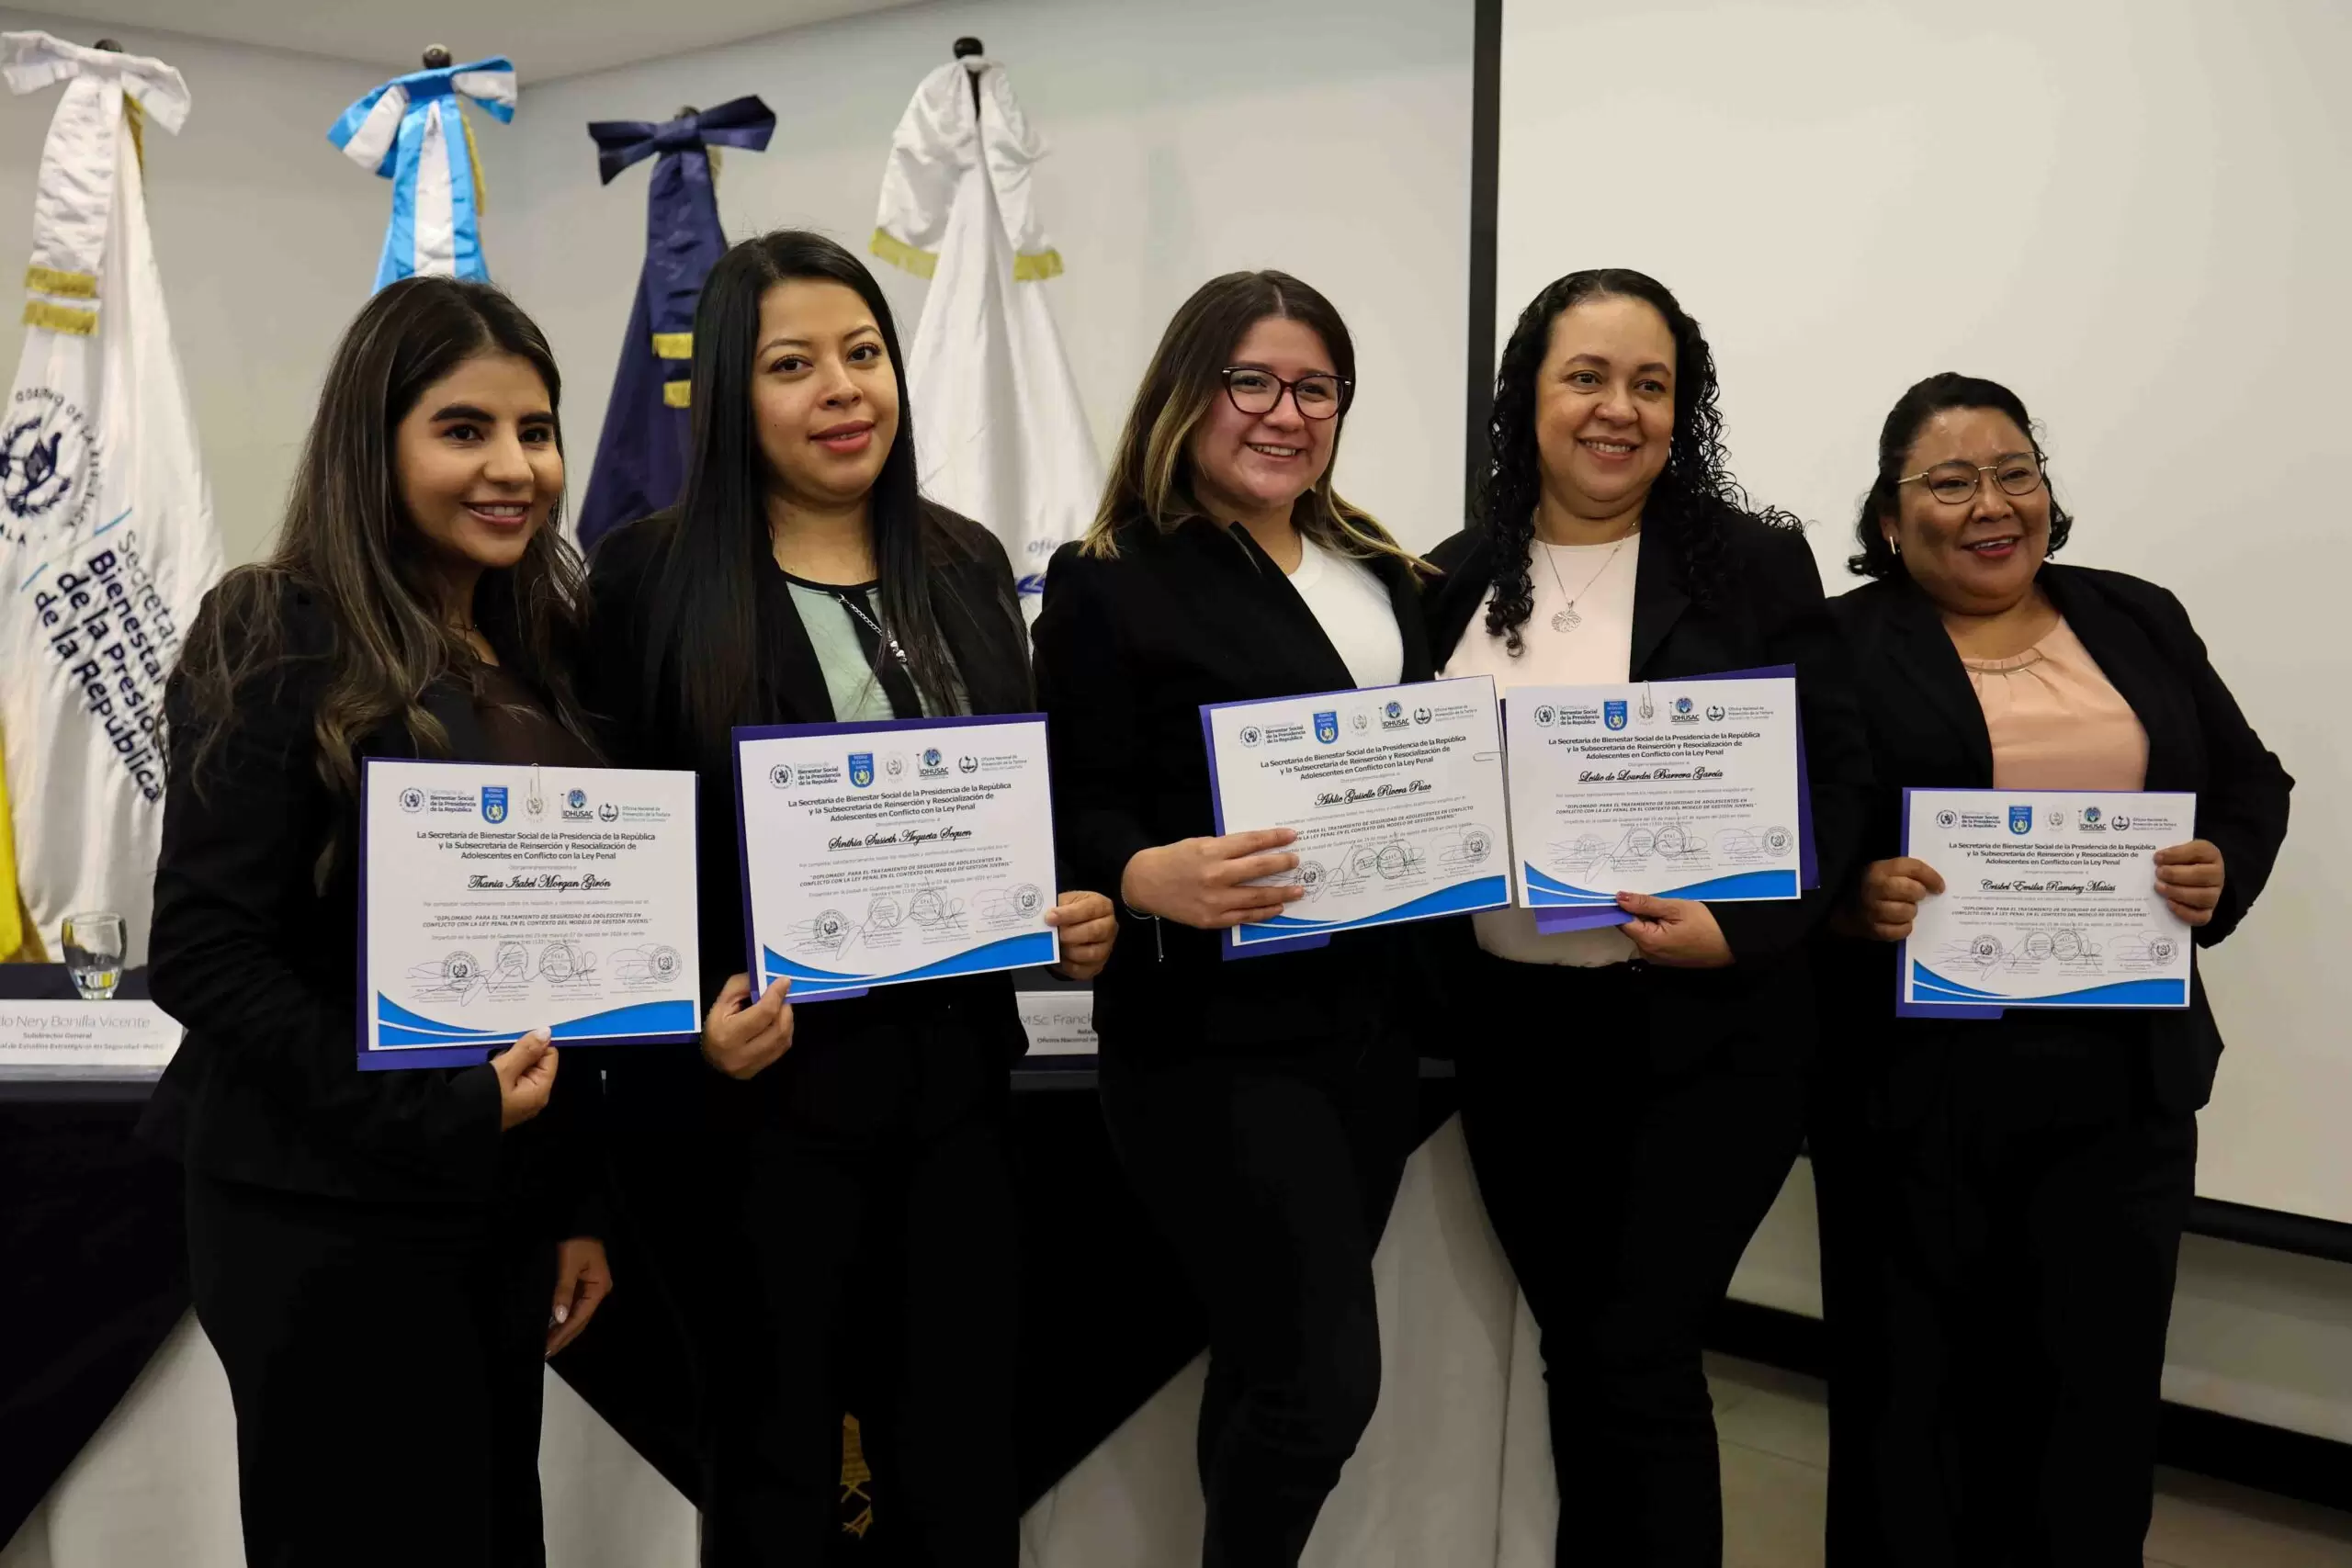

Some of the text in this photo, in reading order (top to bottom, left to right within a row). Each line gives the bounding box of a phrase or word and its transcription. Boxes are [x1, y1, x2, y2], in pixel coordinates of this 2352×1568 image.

[118, 530, 178, 648] Secretar
[57, 573, 158, 750] de la Presid
[35, 592, 160, 801] de la República
[1314, 750, 1346, 761] Bienestar
[1346, 748, 1365, 756] Social
[1382, 741, 1419, 751] Presidencia
[920, 767, 949, 776] IDHUSAC
[1300, 769, 1344, 780] Adolescentes
[1353, 763, 1384, 773] Conflicto
[1403, 759, 1416, 767] Ley
[845, 793, 879, 802] Bienestar
[880, 791, 901, 799] Social
[921, 786, 961, 796] Presidencia
[562, 810, 594, 818] IDHUSAC
[830, 812, 877, 822] Adolescentes
[888, 808, 921, 817] Conflicto
[943, 805, 956, 813] Ley
[16, 1015, 48, 1030] Nery
